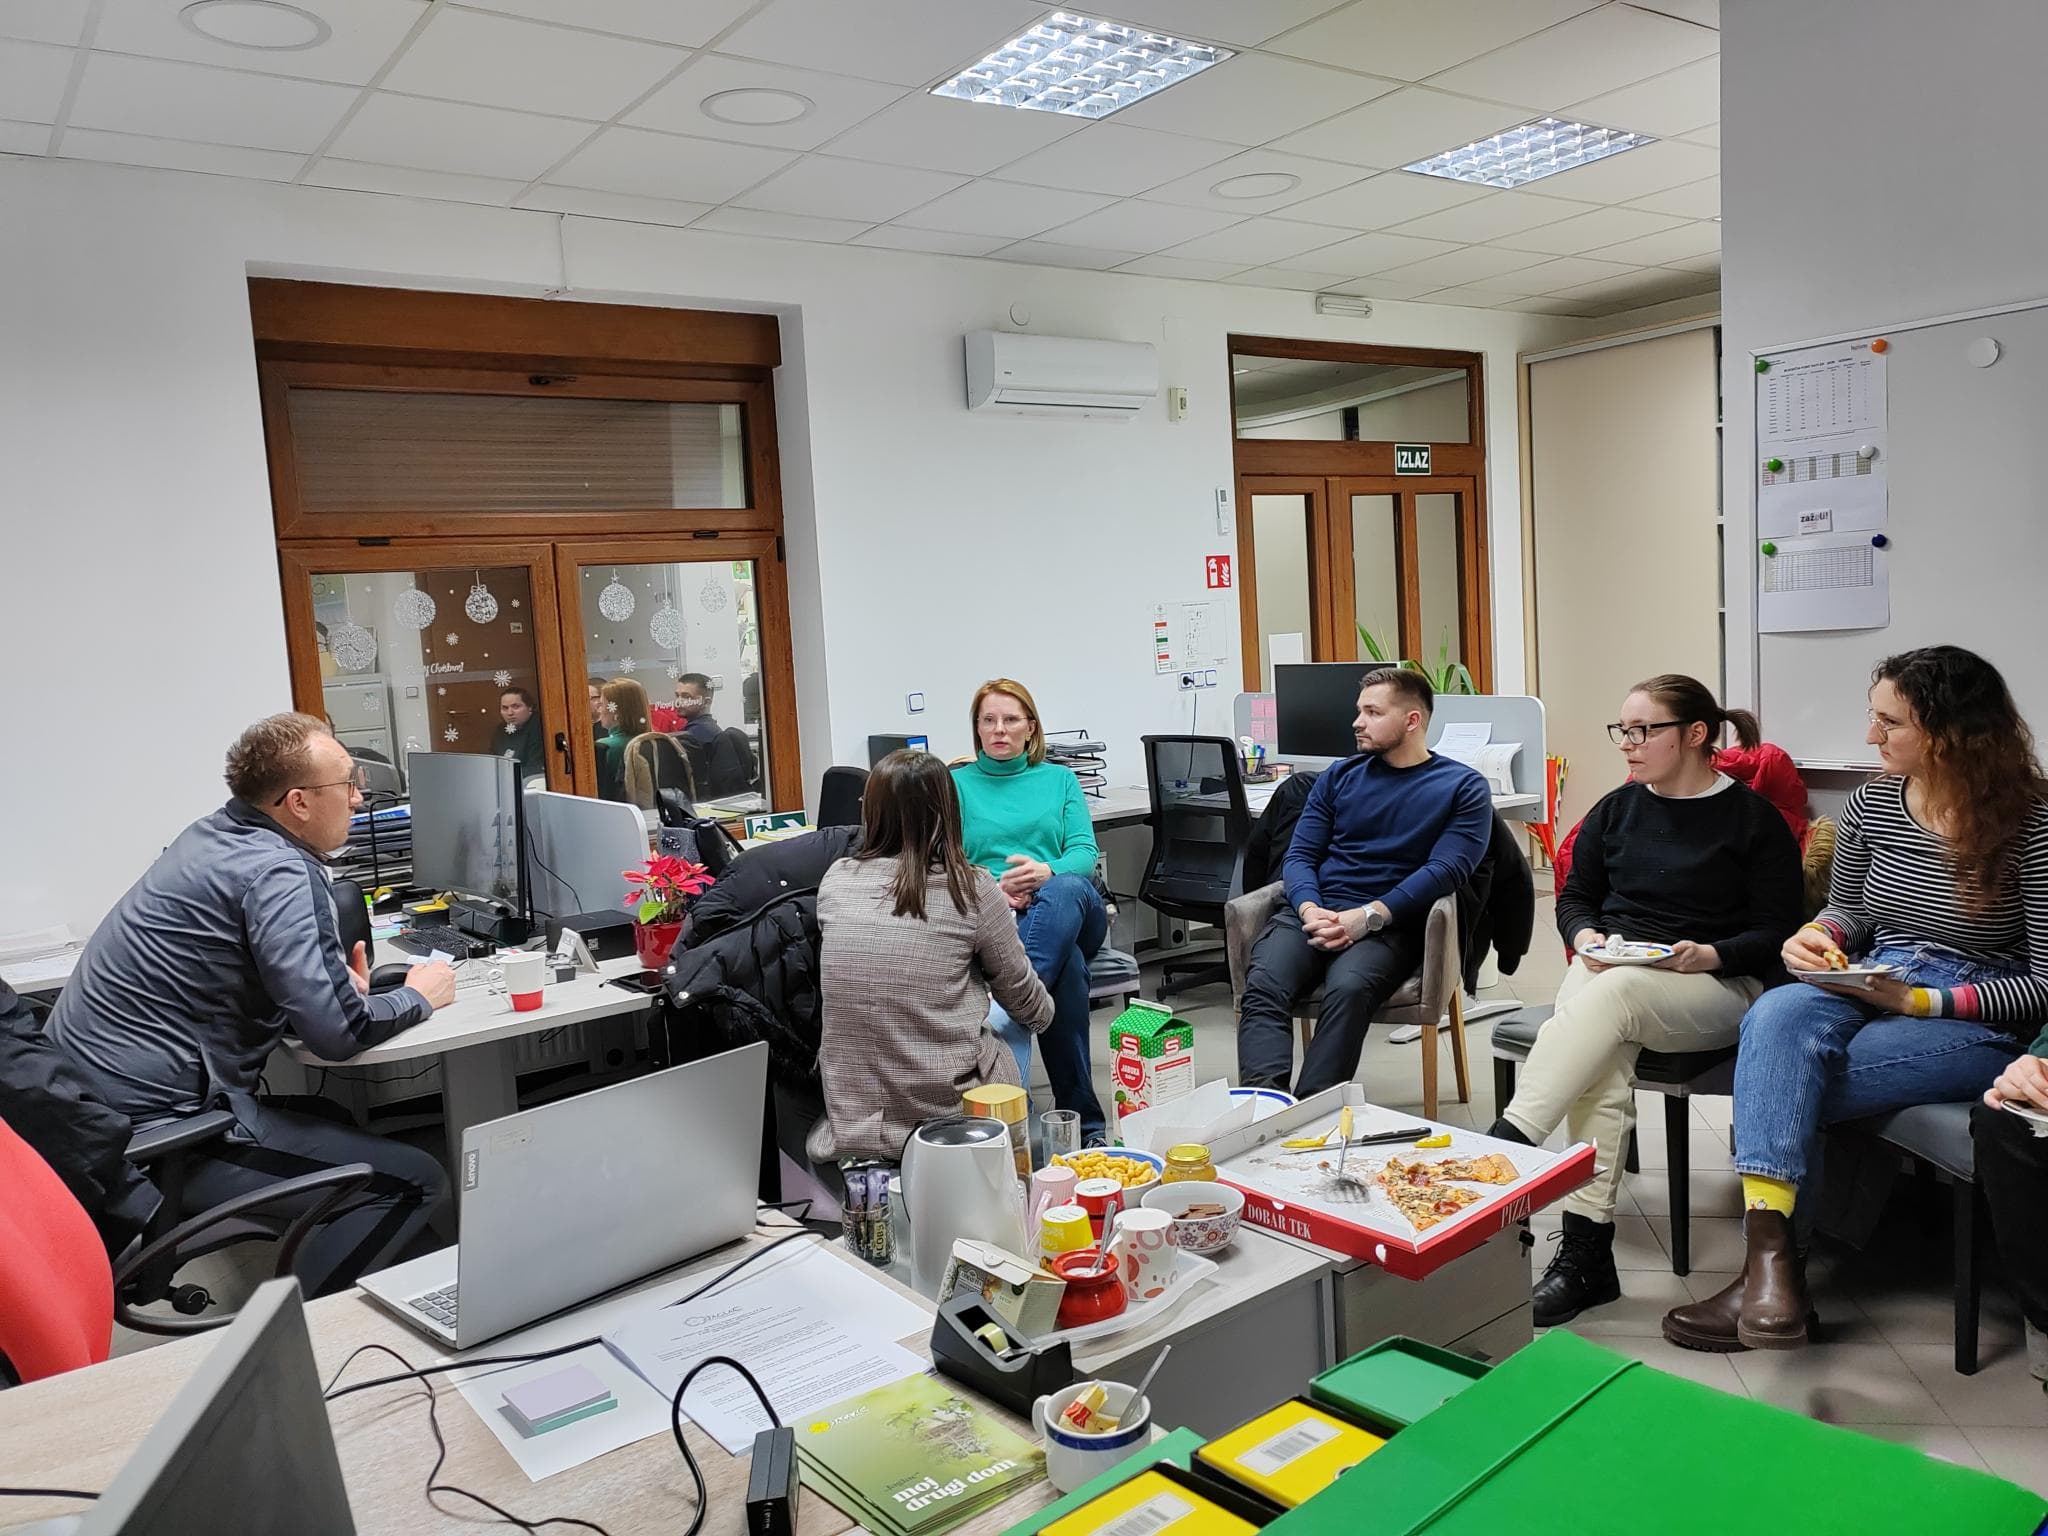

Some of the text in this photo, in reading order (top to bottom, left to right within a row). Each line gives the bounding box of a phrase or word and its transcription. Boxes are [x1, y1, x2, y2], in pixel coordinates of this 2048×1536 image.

[1397, 451, 1429, 468] IZLAZ
[465, 1153, 476, 1188] Lenovo
[1248, 1203, 1312, 1240] DOBAR TEK
[1501, 1192, 1531, 1229] PIZZA
[892, 1476, 940, 1502] moj
[905, 1459, 1018, 1512] drugi dom
